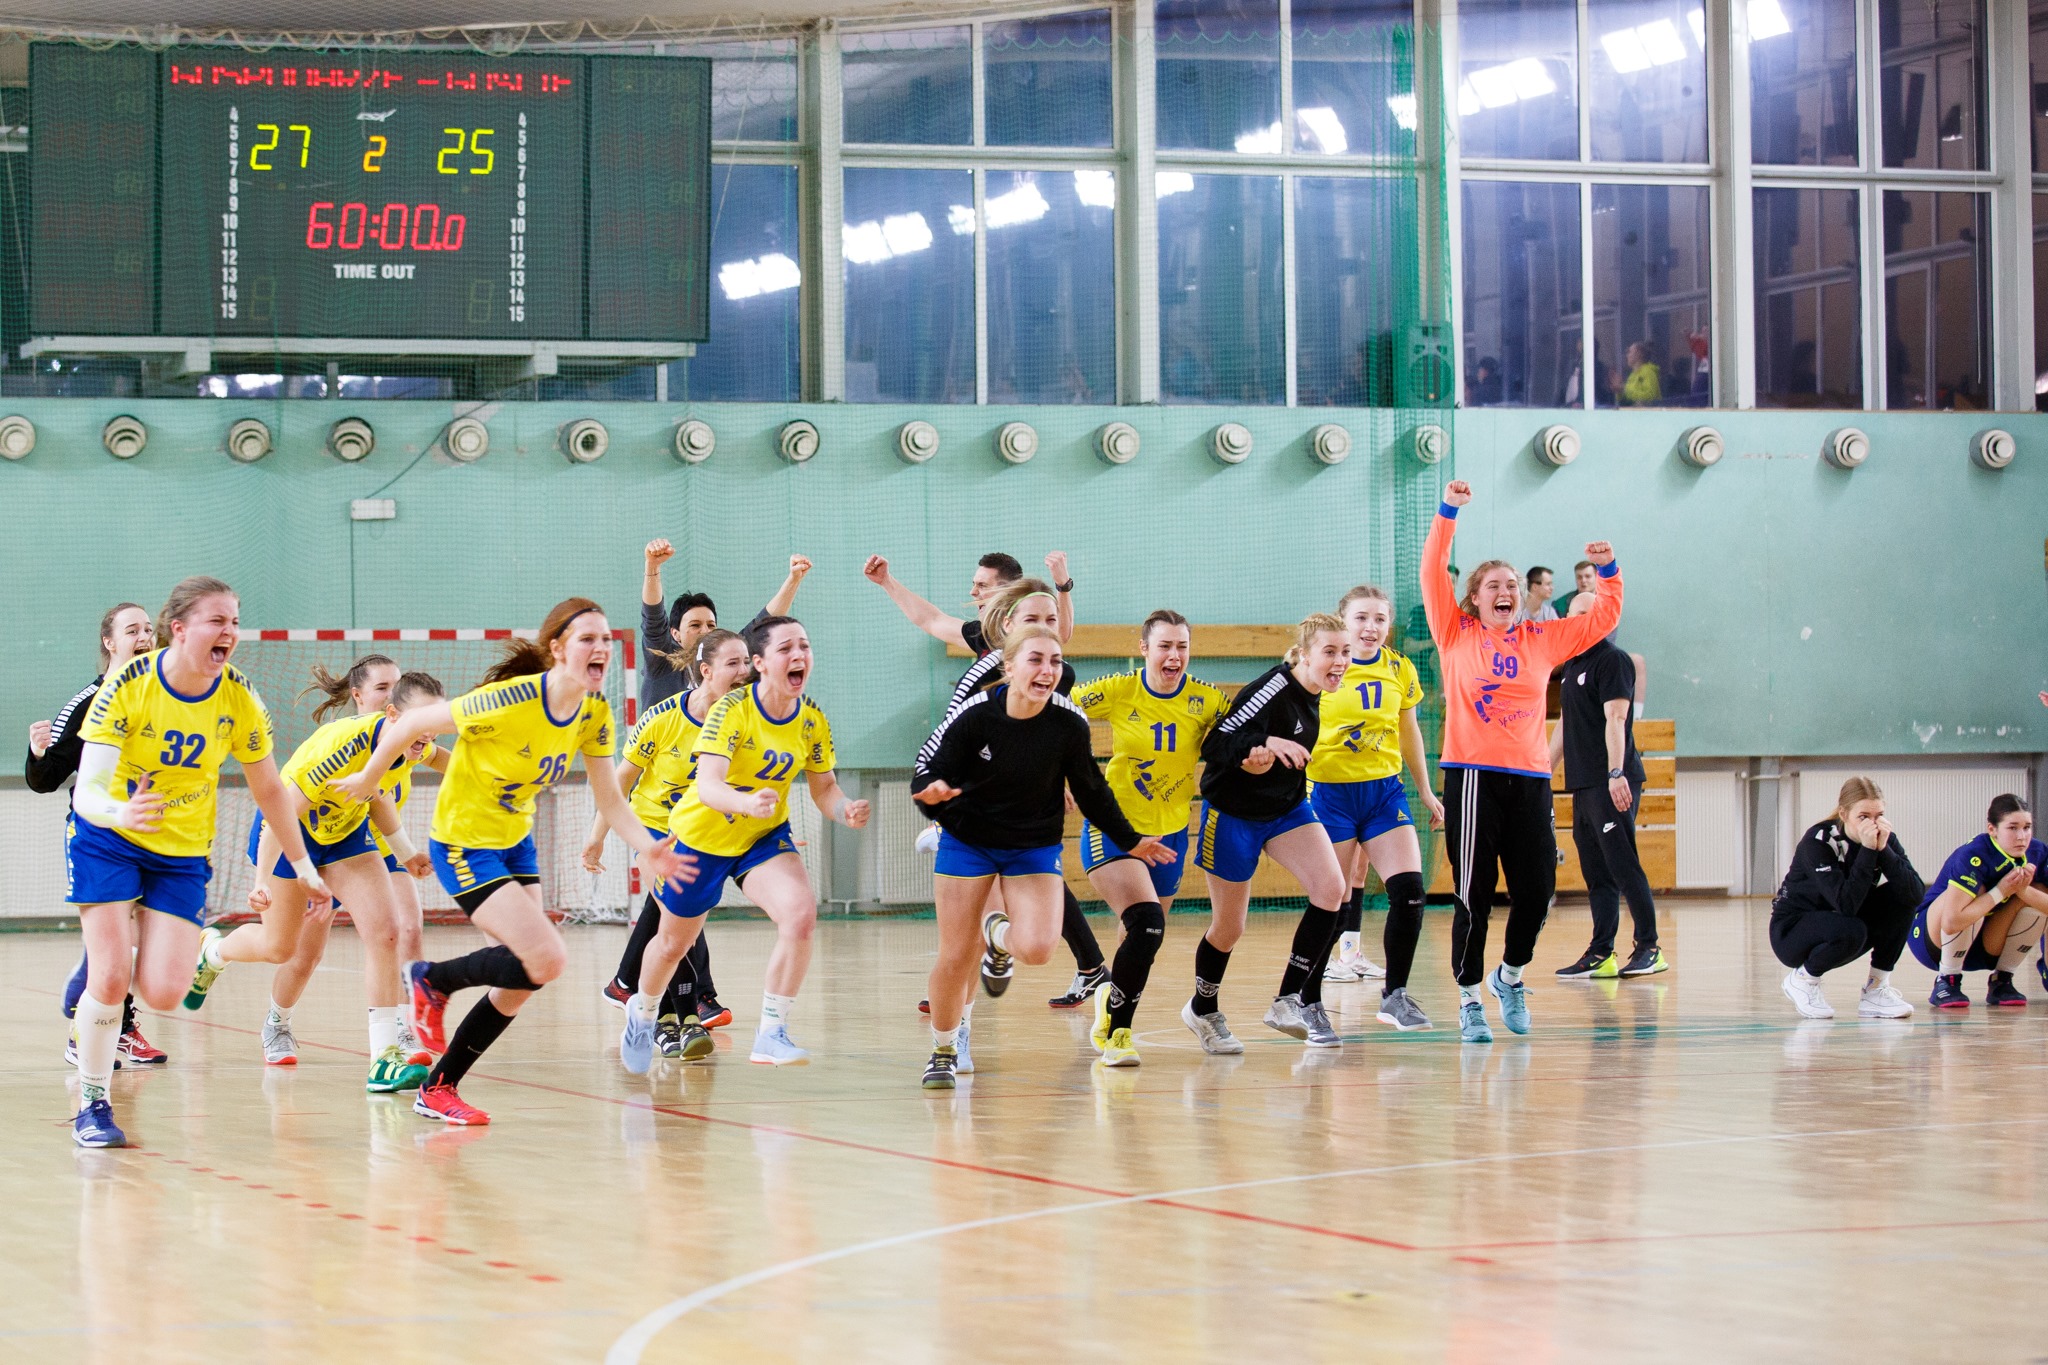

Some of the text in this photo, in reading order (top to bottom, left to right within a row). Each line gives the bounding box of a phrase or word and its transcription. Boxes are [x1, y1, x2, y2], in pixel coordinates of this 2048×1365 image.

[229, 107, 239, 122] 4
[518, 113, 527, 127] 4
[229, 125, 239, 140] 5
[517, 130, 527, 145] 5
[229, 142, 239, 158] 6
[250, 124, 312, 171] 27
[363, 136, 387, 172] 2
[437, 128, 495, 174] 25
[517, 148, 527, 163] 6
[229, 160, 239, 176] 7
[517, 165, 527, 180] 7
[229, 178, 239, 194] 8
[517, 183, 526, 198] 8
[228, 196, 239, 211] 9
[516, 200, 526, 216] 9
[222, 214, 238, 229] 10
[510, 218, 526, 233] 10
[221, 232, 237, 247] 11
[509, 236, 524, 251] 11
[221, 249, 238, 265] 12
[509, 253, 526, 268] 12
[221, 267, 238, 283] 13
[333, 264, 416, 279] TIME OUT
[509, 270, 525, 286] 13
[221, 285, 238, 300] 14
[509, 288, 525, 304] 14
[221, 303, 237, 318] 15
[508, 306, 525, 322] 15
[1492, 652, 1518, 679] 99
[1355, 680, 1383, 710] 17
[1150, 721, 1177, 752] 11
[160, 729, 206, 769] 32
[531, 753, 568, 784] 26
[754, 749, 794, 781] 22
